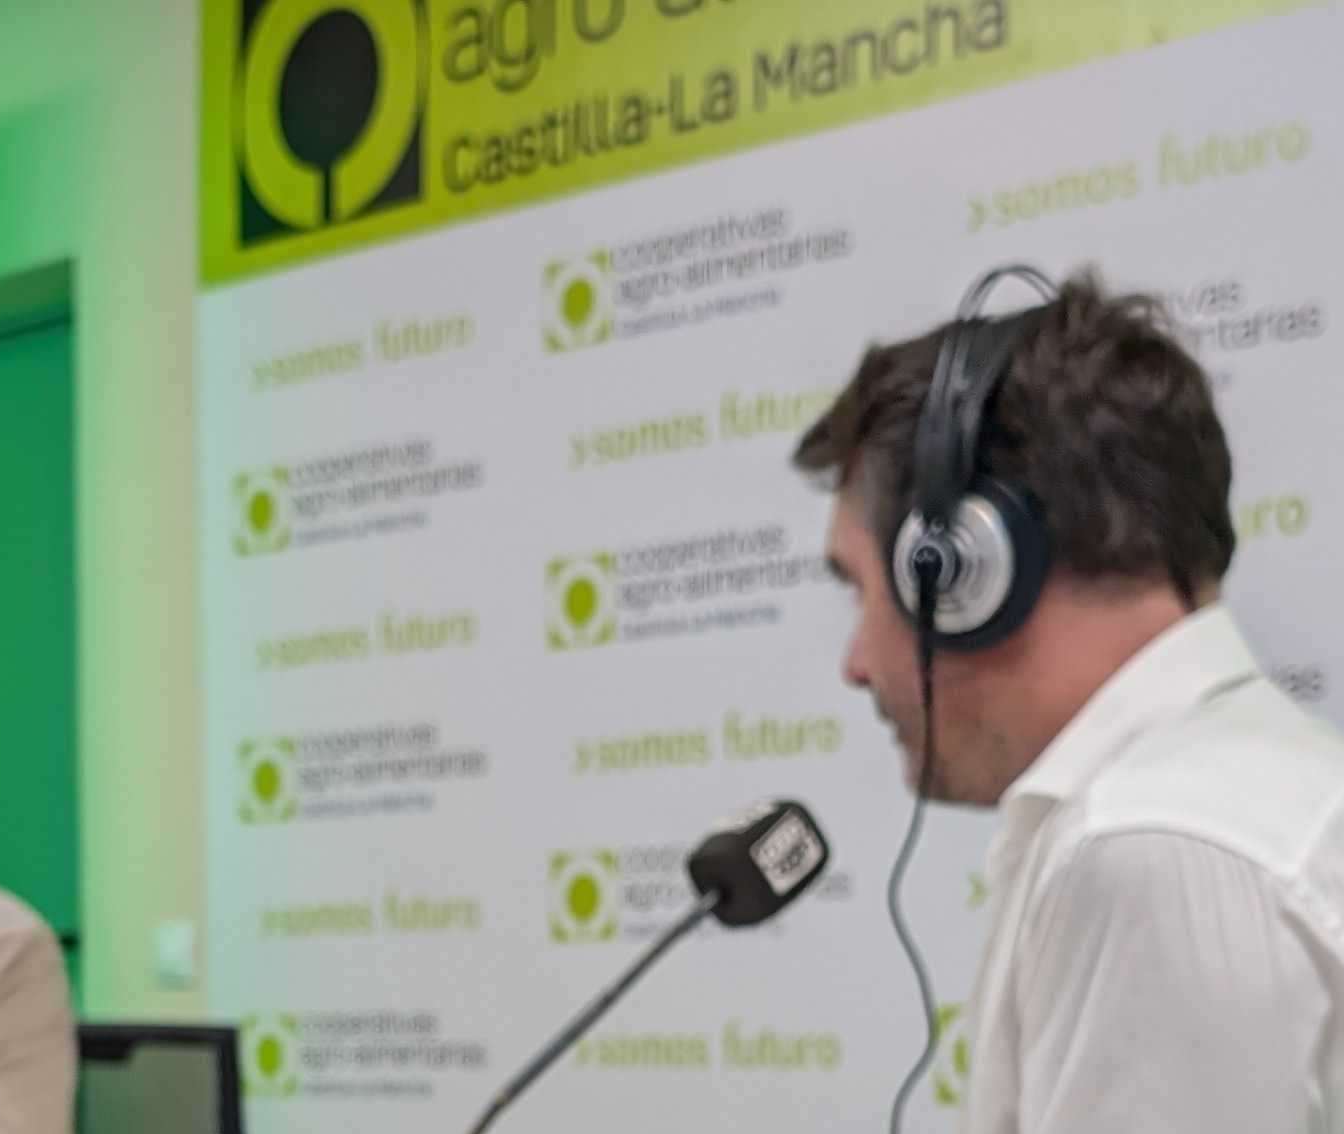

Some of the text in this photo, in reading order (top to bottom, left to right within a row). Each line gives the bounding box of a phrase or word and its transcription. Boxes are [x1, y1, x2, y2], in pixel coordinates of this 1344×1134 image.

[441, 0, 1008, 194] Castilla-La Mancha
[1158, 119, 1311, 188] futuro
[723, 712, 844, 759] futuro
